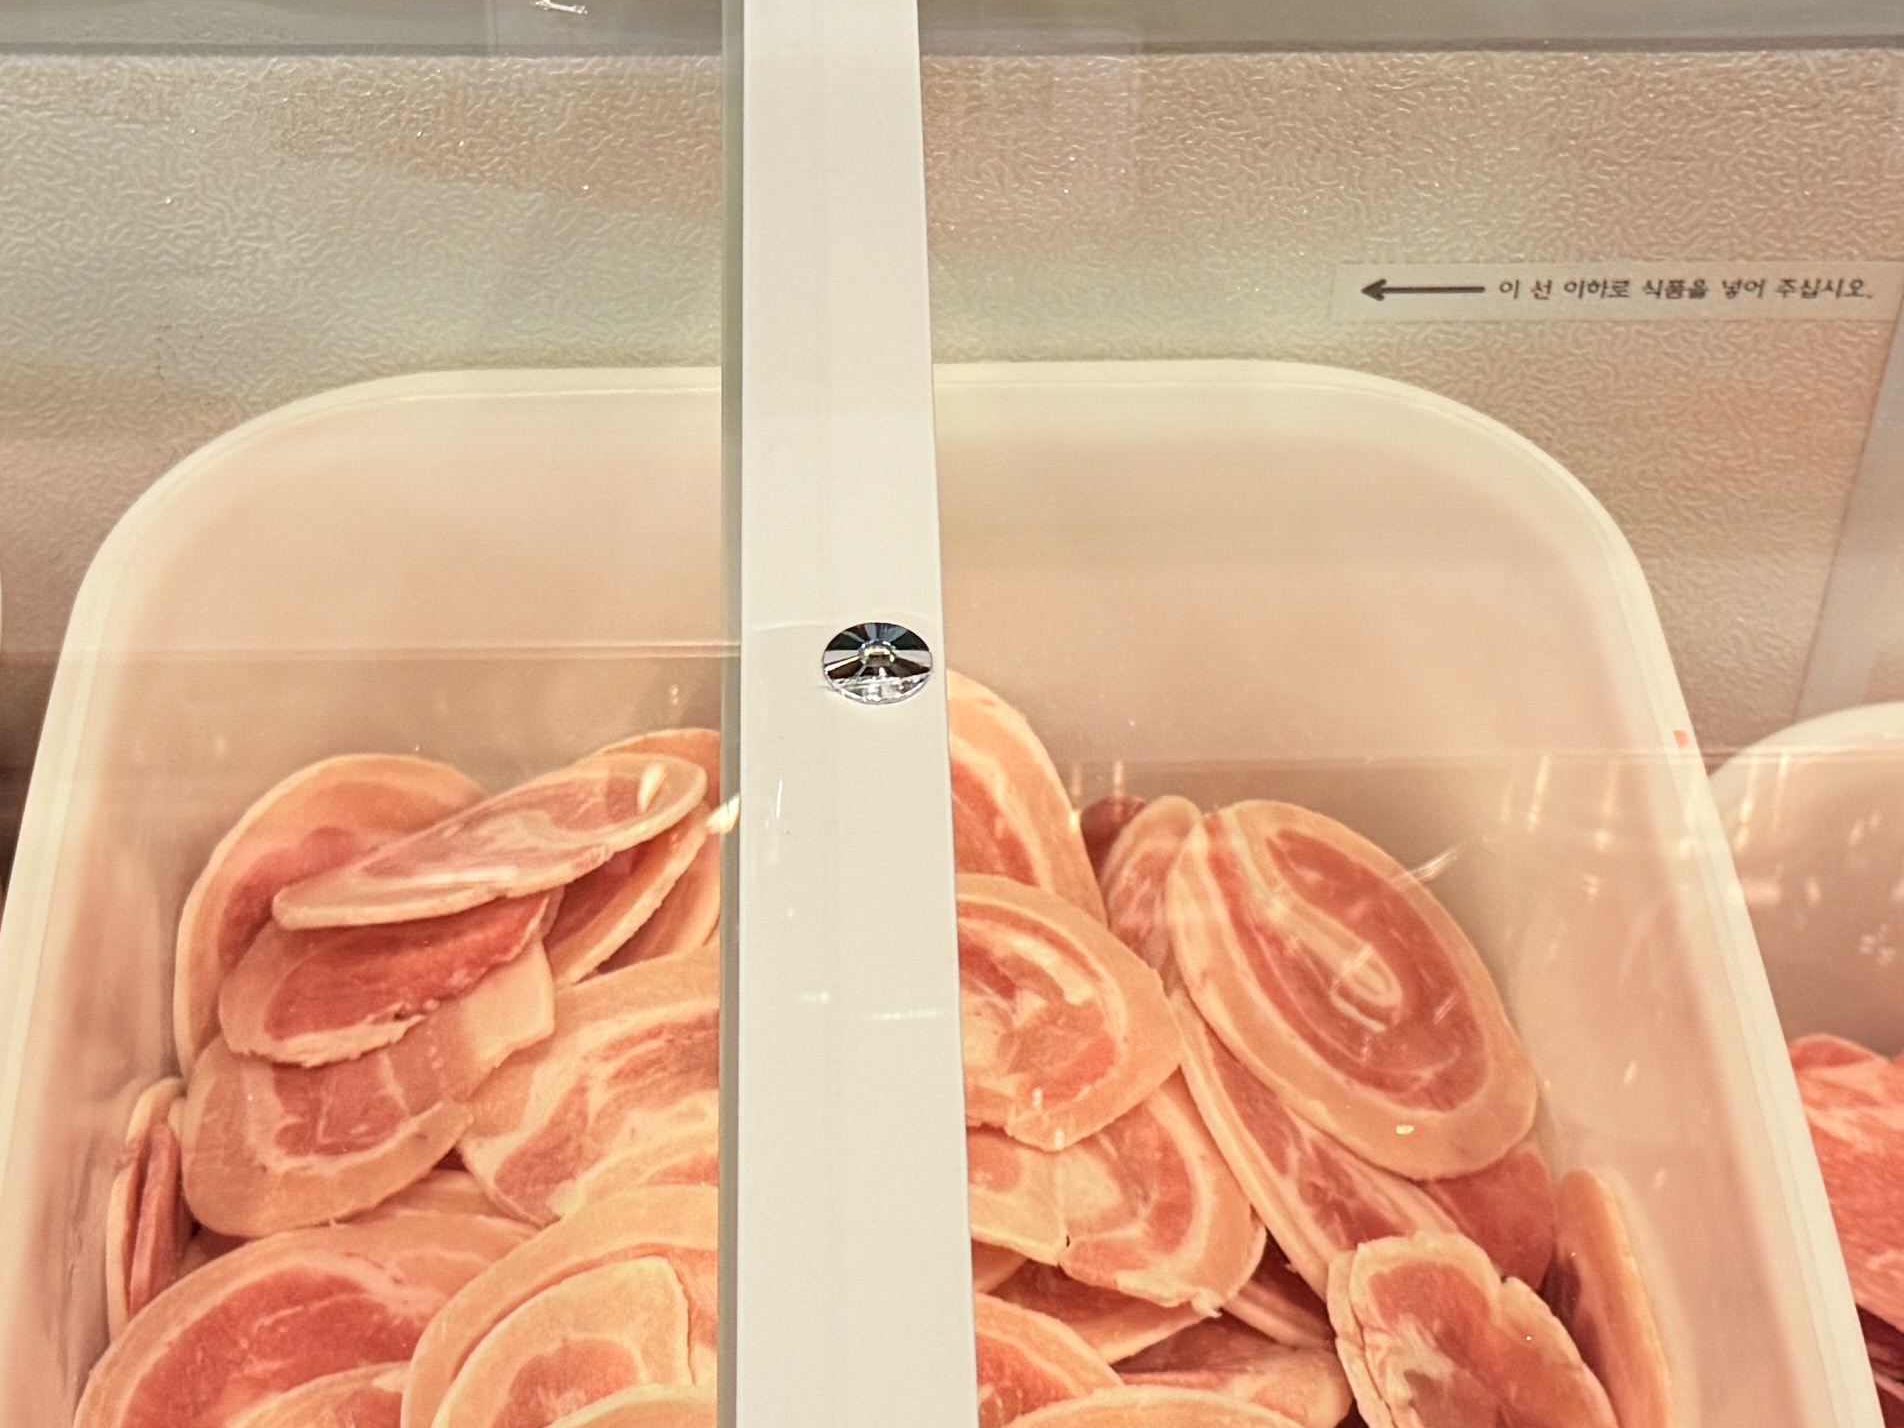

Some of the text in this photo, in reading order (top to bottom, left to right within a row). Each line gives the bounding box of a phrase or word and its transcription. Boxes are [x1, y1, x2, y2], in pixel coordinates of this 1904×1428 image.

[1498, 277, 1874, 301] 이 선 이하로 식품을 넣어 주십시오.
